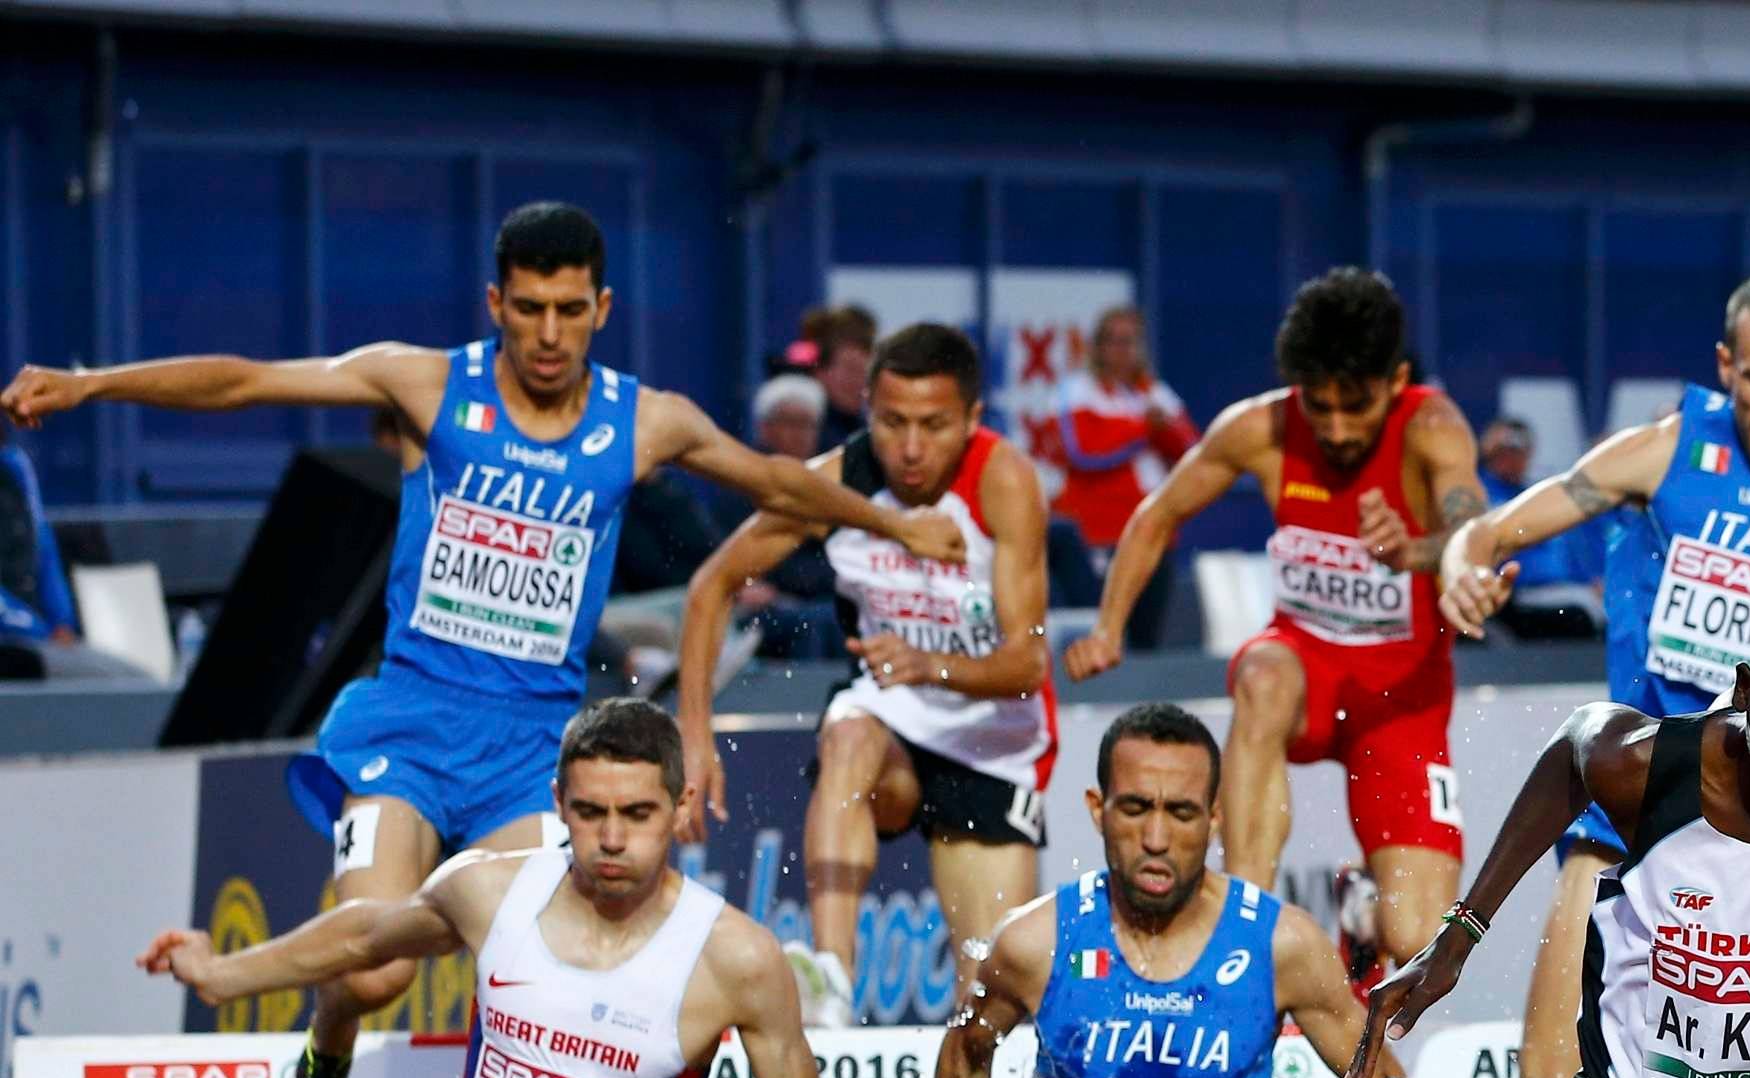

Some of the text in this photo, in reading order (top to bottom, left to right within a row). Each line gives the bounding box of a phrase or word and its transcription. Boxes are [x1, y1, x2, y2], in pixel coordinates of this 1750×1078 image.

[456, 462, 595, 527] ITALIA
[438, 503, 551, 559] SPAR
[430, 542, 574, 613] BAMOUSSA
[1281, 564, 1403, 612] CARRO
[1671, 890, 1715, 911] TAF
[485, 1006, 640, 1073] GREAT BRITAIN
[1083, 1019, 1230, 1073] ITALIA
[1656, 995, 1705, 1060] Ar.
